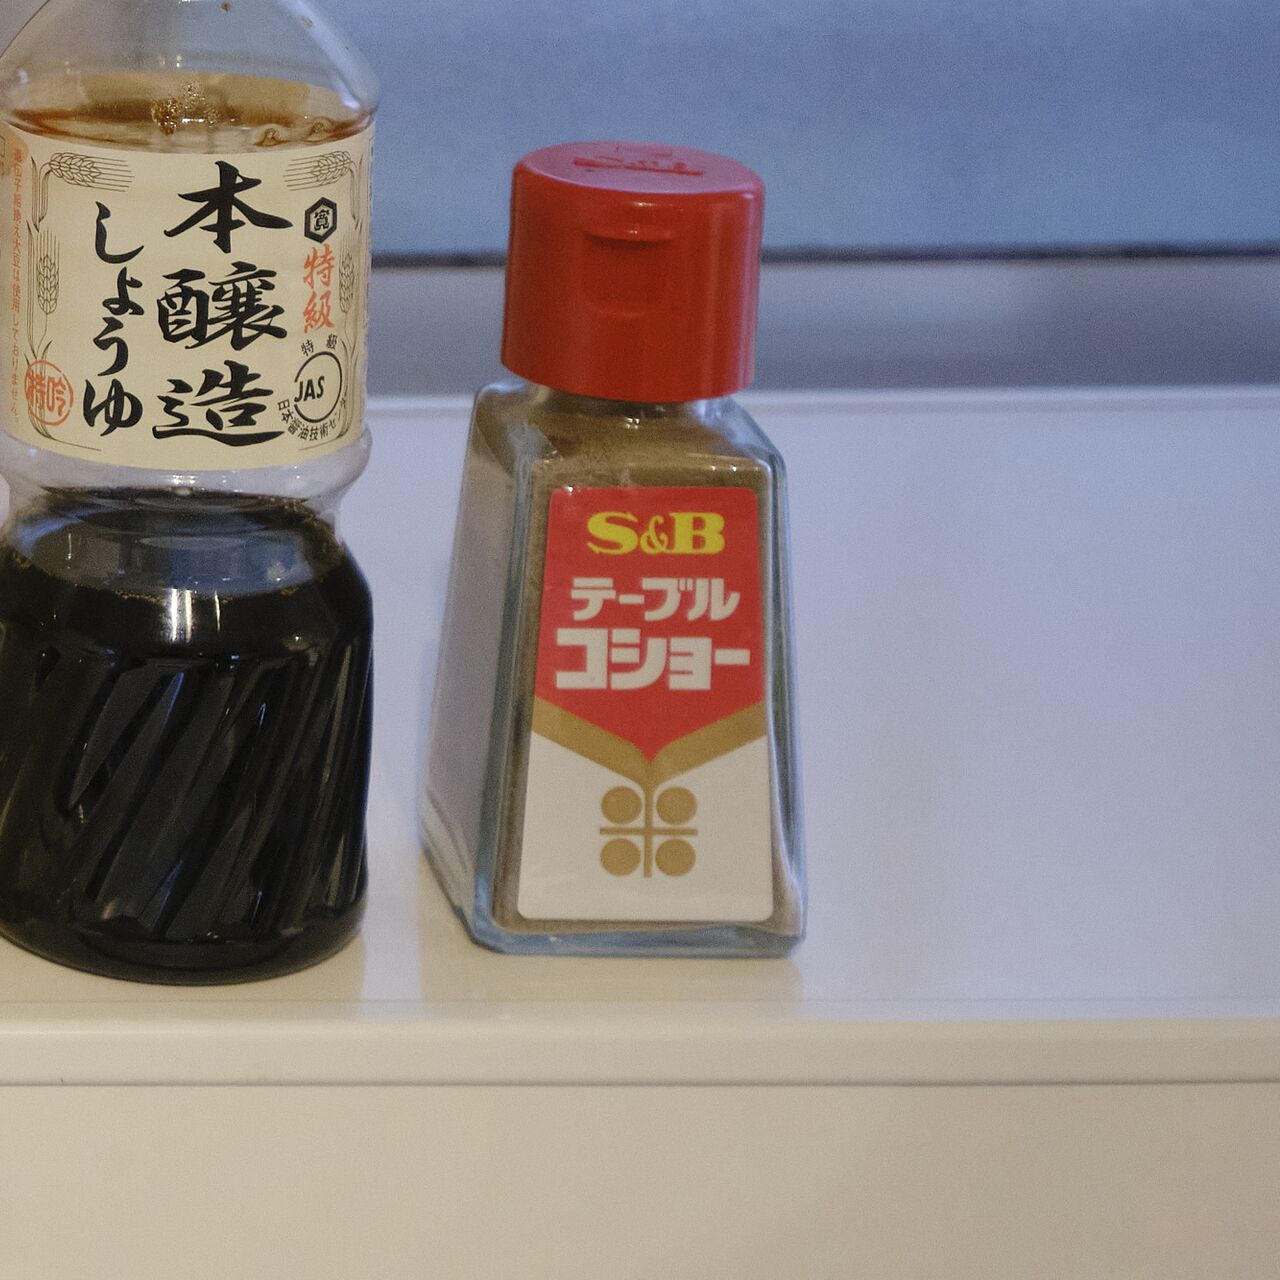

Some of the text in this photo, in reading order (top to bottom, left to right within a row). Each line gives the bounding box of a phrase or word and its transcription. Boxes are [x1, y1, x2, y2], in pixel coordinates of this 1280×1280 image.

[82, 201, 145, 437] しょうゆ
[151, 160, 294, 447] 本醸造
[303, 243, 336, 333] 特級
[293, 375, 325, 403] JAS
[586, 511, 726, 555] S&B
[571, 577, 741, 621] テーブル
[555, 628, 752, 690] コショー
